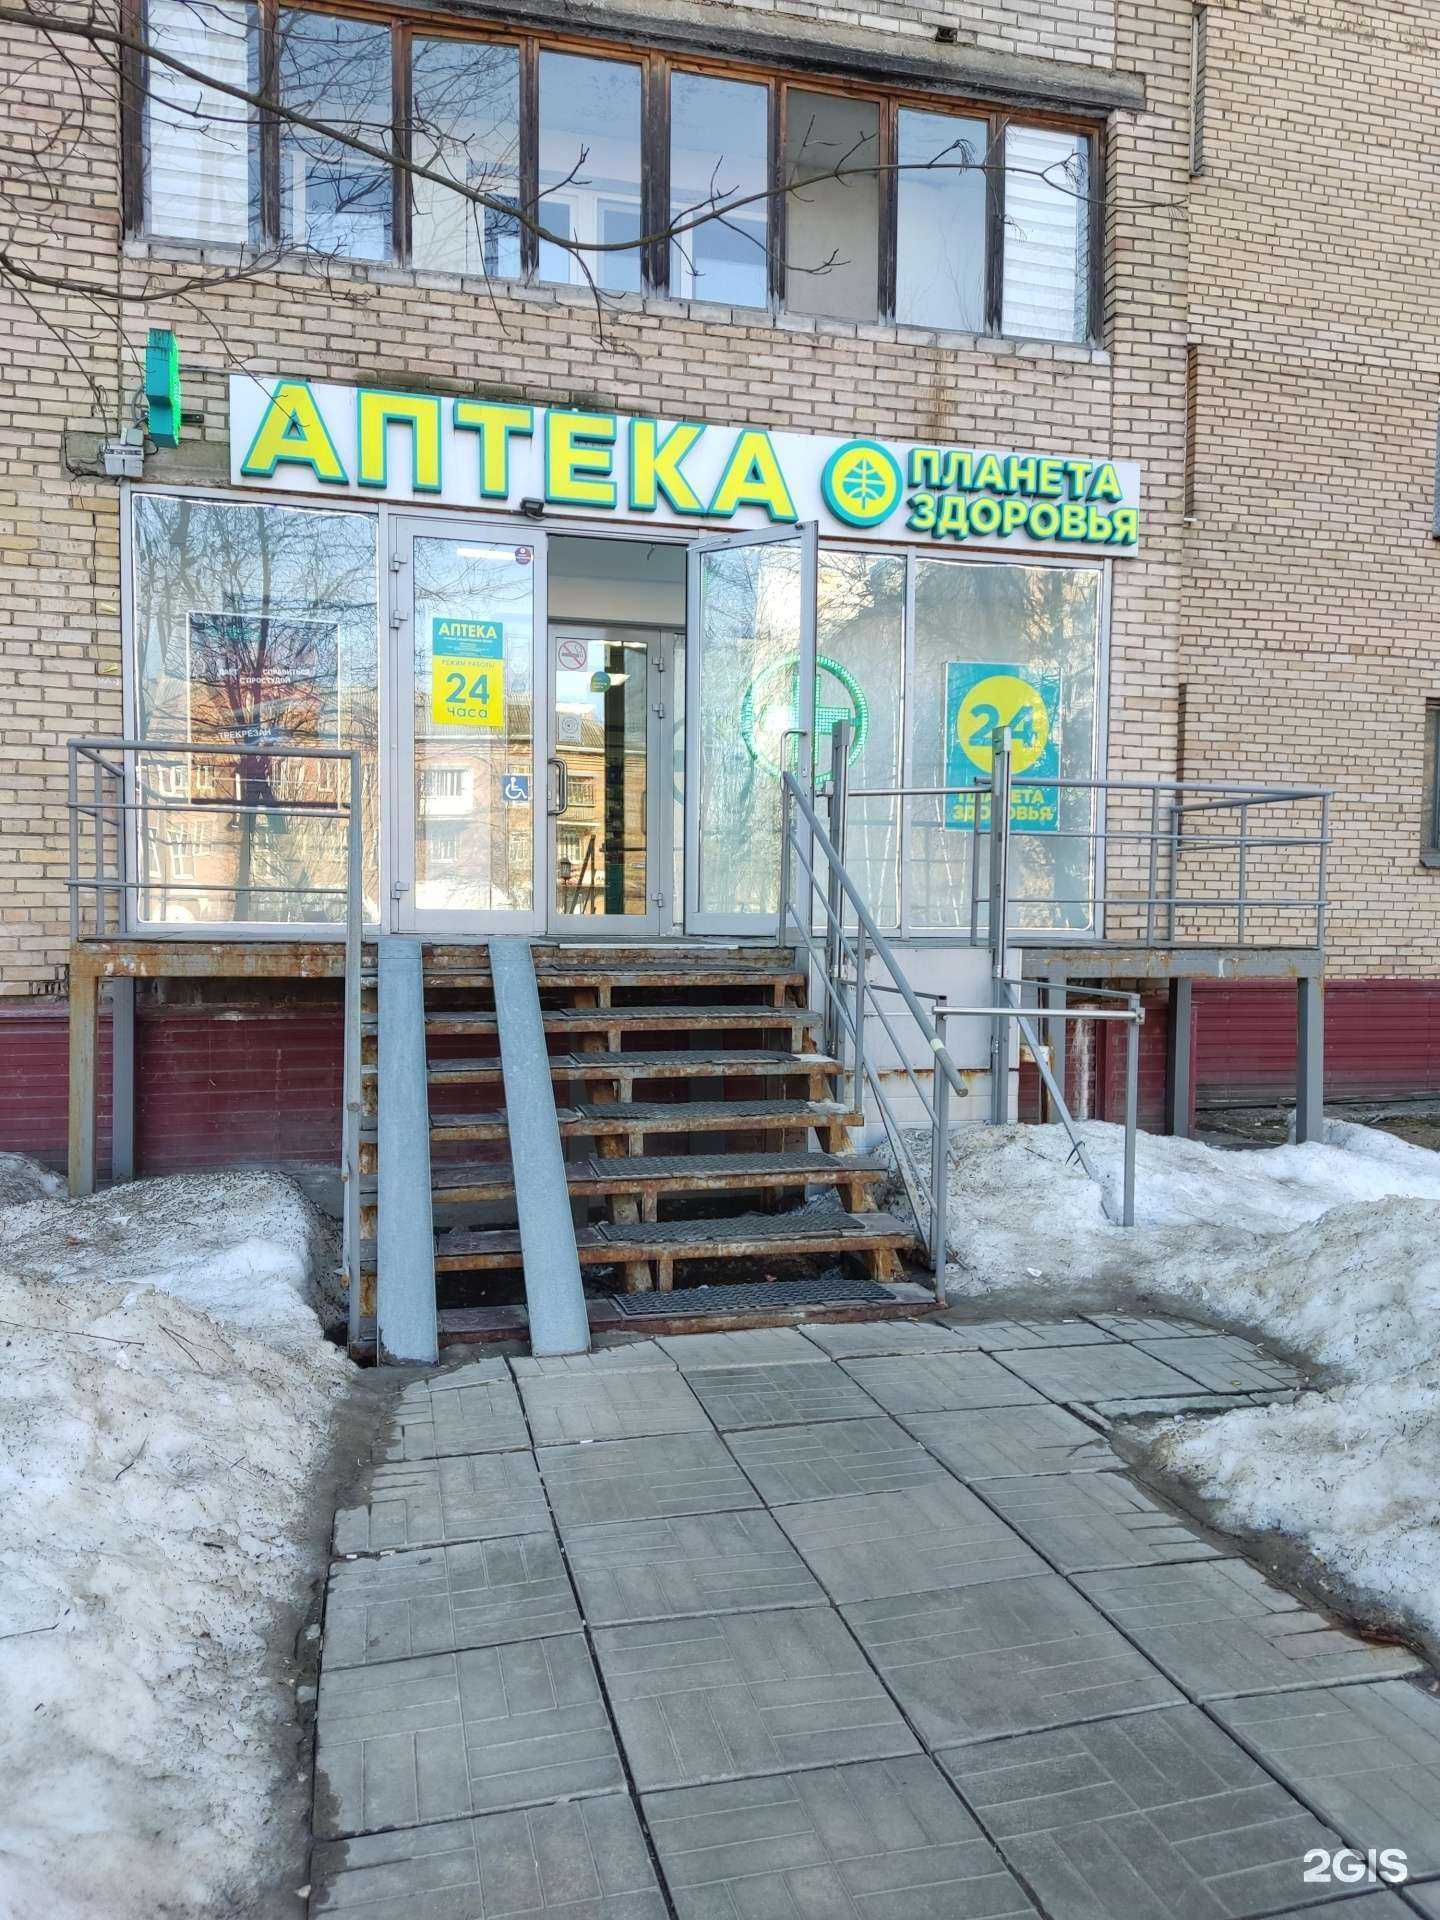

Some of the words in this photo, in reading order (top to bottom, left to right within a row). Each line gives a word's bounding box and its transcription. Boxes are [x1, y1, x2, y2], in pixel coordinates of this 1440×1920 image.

[240, 380, 799, 523] АПТЕКА
[908, 448, 1123, 502] ПЛАНЕТА
[906, 492, 1138, 545] ЗДОРОВЬЯ
[438, 622, 498, 639] АПТЕКА
[446, 672, 490, 705] 24
[969, 703, 1037, 748] 24
